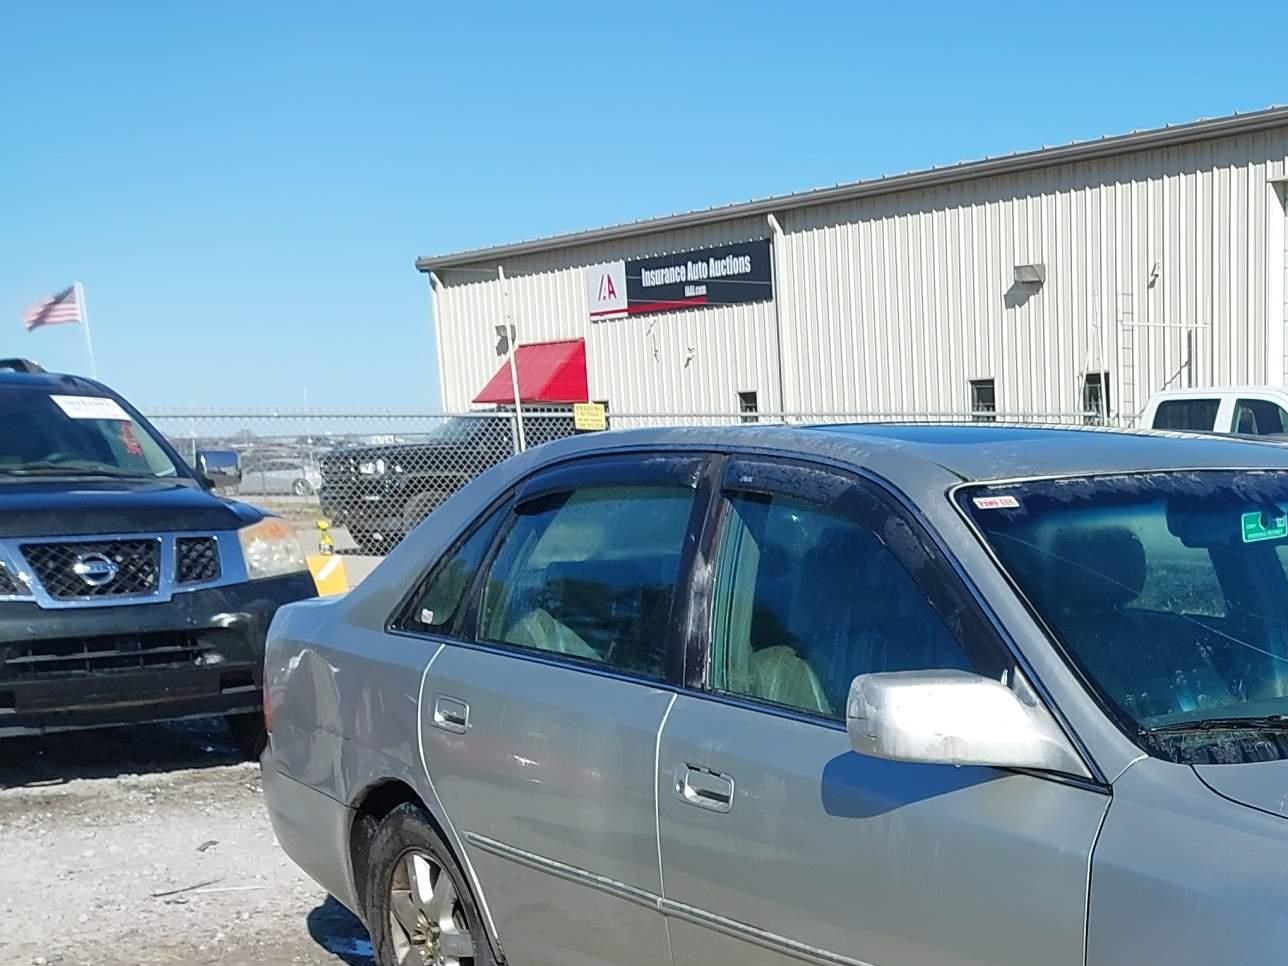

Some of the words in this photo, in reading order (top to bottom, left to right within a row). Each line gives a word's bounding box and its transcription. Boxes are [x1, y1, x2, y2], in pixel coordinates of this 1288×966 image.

[641, 265, 686, 287] Insurance
[687, 261, 708, 281] Auto
[709, 254, 751, 278] Auctions
